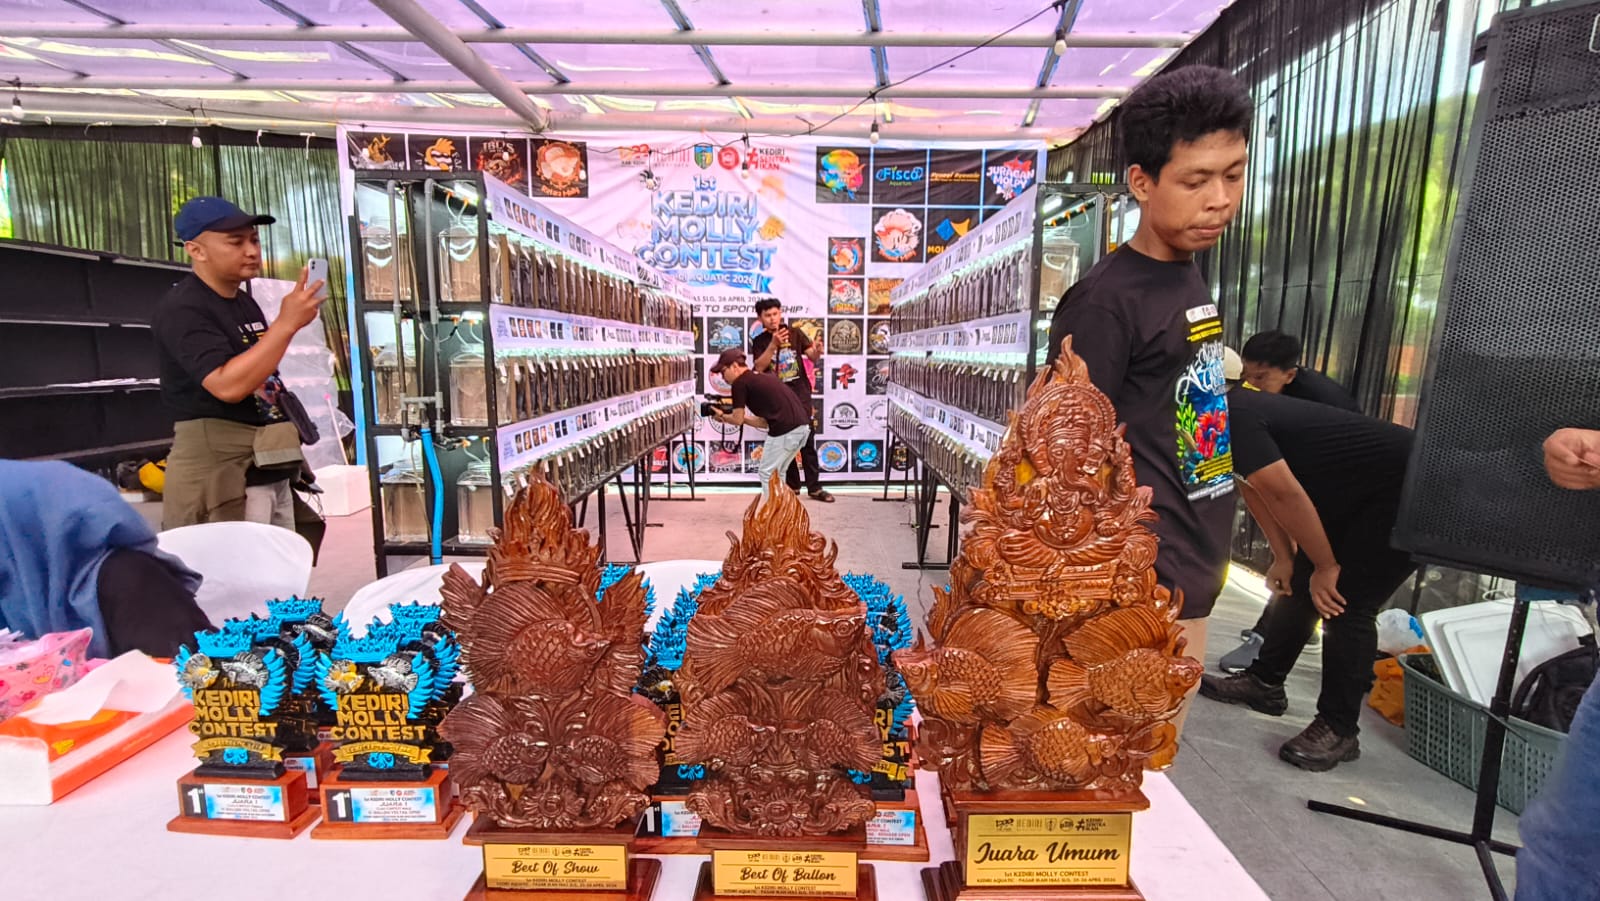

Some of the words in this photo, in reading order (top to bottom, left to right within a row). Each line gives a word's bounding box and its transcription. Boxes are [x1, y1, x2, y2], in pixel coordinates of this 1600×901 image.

[884, 167, 918, 180] Fisco
[986, 166, 1034, 179] JURAGAN
[693, 175, 716, 192] 1st
[652, 190, 757, 218] KEDIRI
[650, 216, 760, 244] MOLLY
[634, 244, 778, 270] CONTEST
[690, 273, 730, 282] AQUATIC
[192, 690, 260, 706] KEDIRI
[336, 694, 409, 711] KEDIRI
[194, 706, 260, 722] MOLLY
[336, 711, 408, 726] MOLLY
[188, 722, 278, 737] CONTEST
[330, 726, 426, 740] CONTEST
[974, 842, 1039, 864] Juara
[1046, 842, 1120, 864] Umum
[512, 861, 539, 874] Best
[543, 861, 560, 876] Of
[563, 861, 599, 874] Show
[740, 867, 768, 880] Best
[772, 867, 788, 882] Of
[793, 867, 836, 882] Ballon
